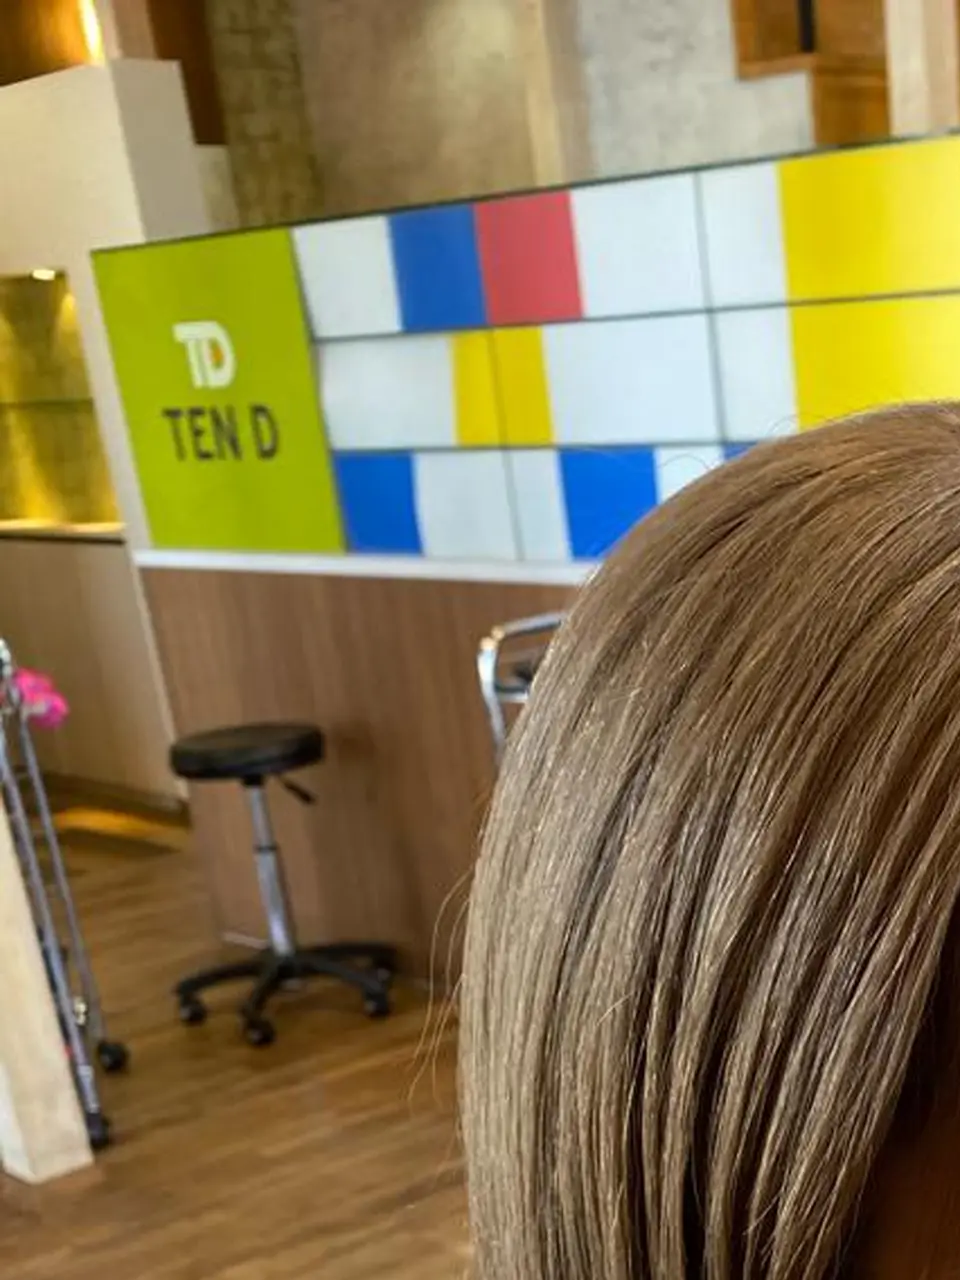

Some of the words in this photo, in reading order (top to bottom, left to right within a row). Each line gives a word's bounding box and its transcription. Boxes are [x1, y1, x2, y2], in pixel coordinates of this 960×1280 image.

[172, 320, 236, 388] TD
[162, 404, 242, 461] TEN
[250, 404, 280, 460] D
